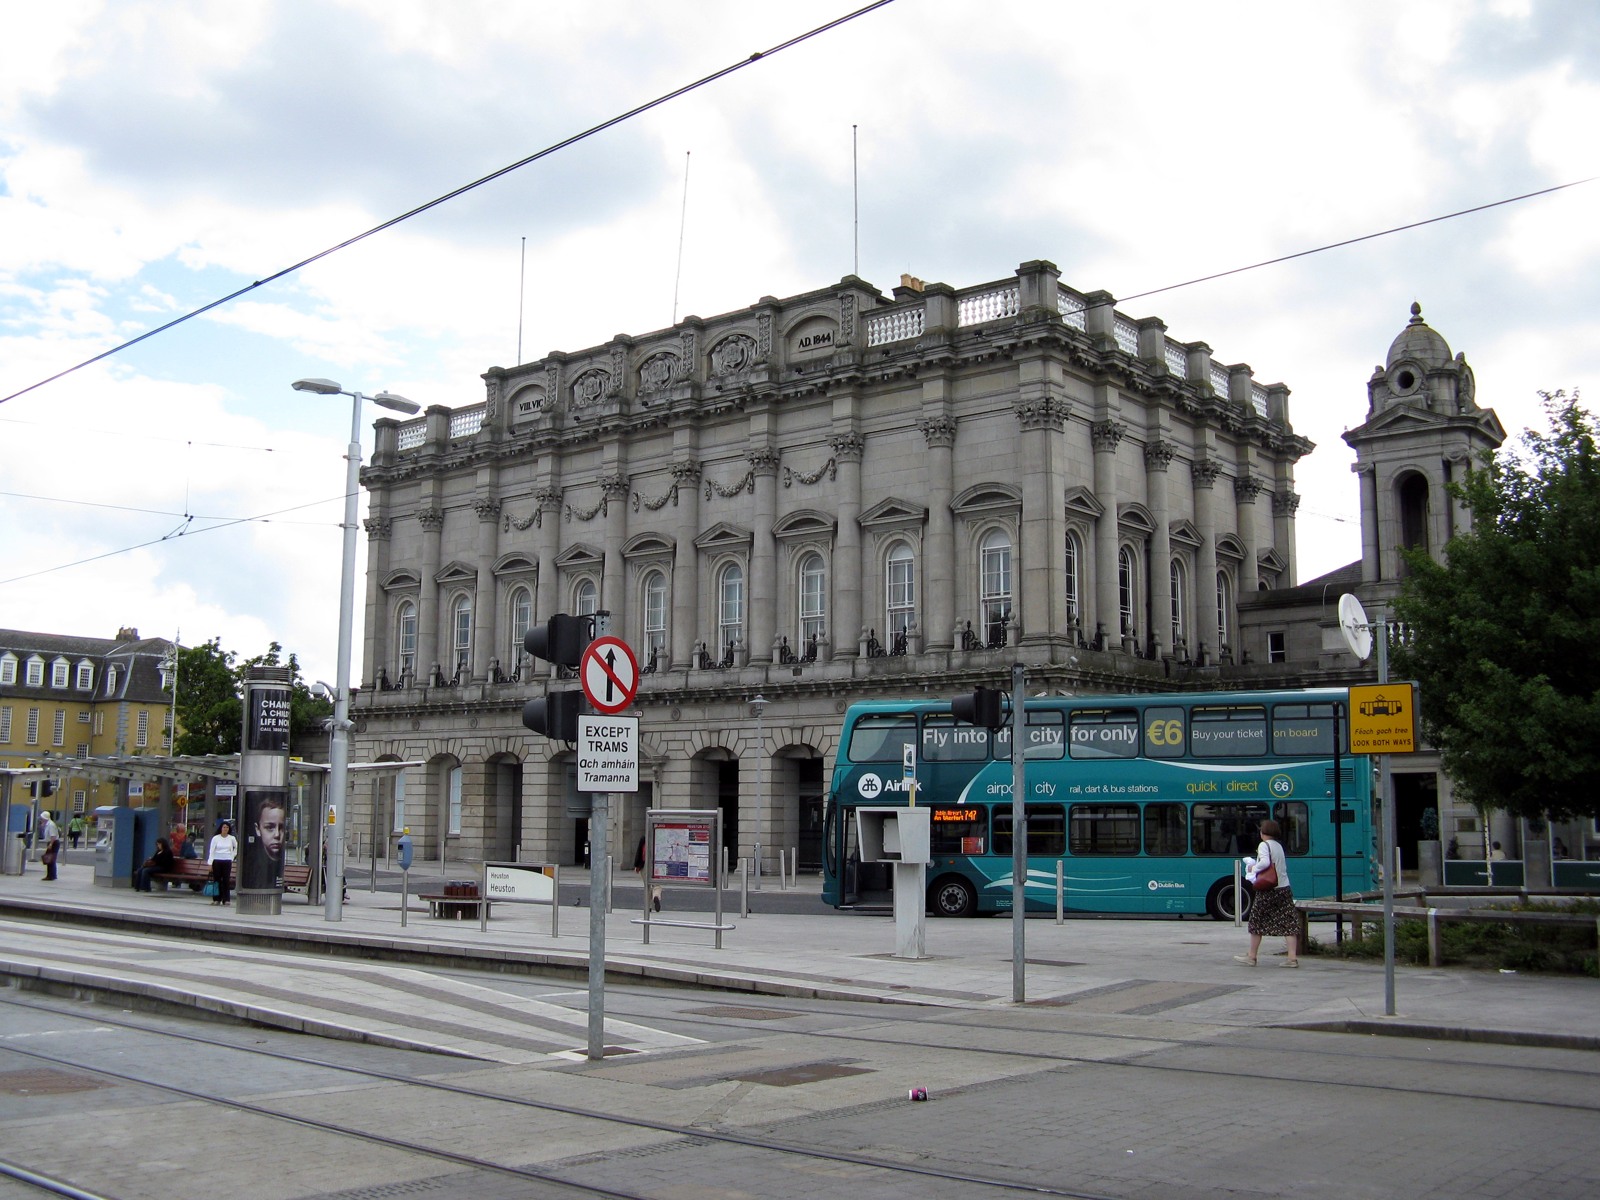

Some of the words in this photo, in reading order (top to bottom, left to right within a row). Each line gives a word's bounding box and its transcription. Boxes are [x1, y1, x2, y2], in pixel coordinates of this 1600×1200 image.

[813, 333, 831, 345] 1844
[261, 700, 290, 708] CHANG
[585, 726, 631, 738] EXCEPT
[923, 729, 948, 747] Fly
[953, 729, 987, 744] into
[998, 729, 1011, 743] th
[1030, 726, 1062, 745] city
[1070, 726, 1097, 741] for
[1100, 725, 1138, 744] only
[1147, 720, 1183, 745] €6
[1192, 730, 1211, 740] Buy
[1213, 731, 1233, 739] your
[1237, 729, 1264, 738] ticket
[1289, 728, 1318, 737] board
[588, 741, 628, 752] TRAMS
[601, 759, 635, 769] amháin
[584, 772, 630, 783] Tramanna
[1035, 781, 1057, 797] city
[1069, 785, 1083, 794] rail,
[1085, 784, 1101, 793] dart
[1103, 785, 1109, 793] &
[1110, 784, 1126, 793] bus
[1127, 784, 1159, 793] stations
[1186, 780, 1218, 794] quick
[1226, 780, 1258, 792] direct
[1274, 781, 1289, 792] €6
[490, 872, 509, 880] Heuston
[490, 883, 516, 893] Heuston
